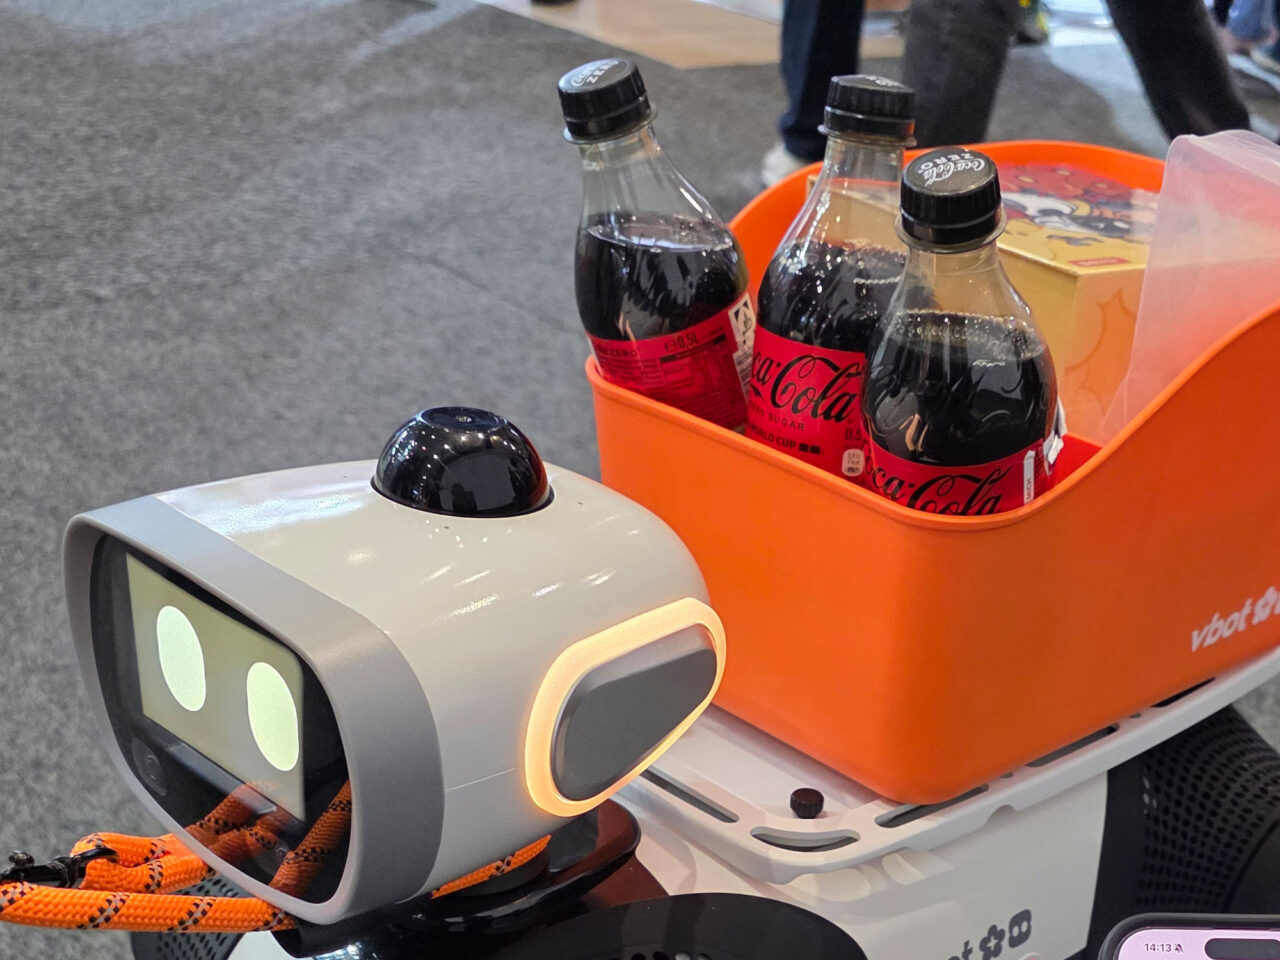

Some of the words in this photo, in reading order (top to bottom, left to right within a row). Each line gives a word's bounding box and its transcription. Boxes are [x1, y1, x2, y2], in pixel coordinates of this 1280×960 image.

[920, 153, 975, 171] ZERO
[752, 351, 862, 423] ca-Cola
[768, 412, 806, 431] SUGAR
[775, 435, 797, 449] CUP
[864, 440, 1013, 516] oca-Cola
[1191, 598, 1252, 653] vbot
[1144, 943, 1172, 952] 14:13
